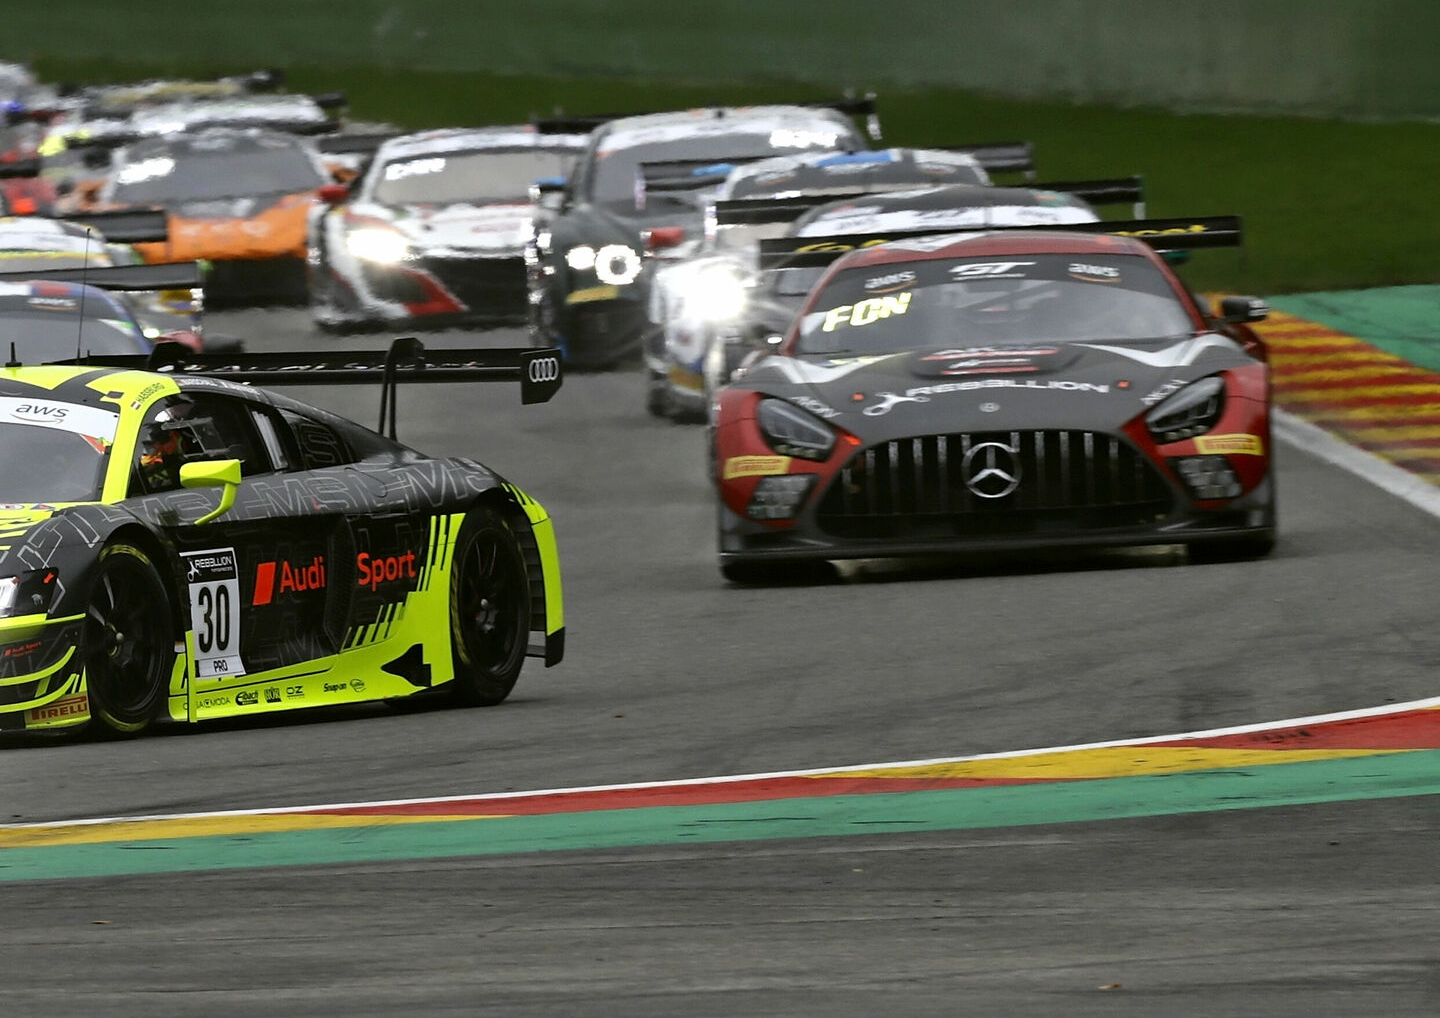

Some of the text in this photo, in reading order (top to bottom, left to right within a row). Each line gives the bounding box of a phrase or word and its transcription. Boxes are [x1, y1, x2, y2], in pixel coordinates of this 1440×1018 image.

[1068, 263, 1120, 277] aws
[865, 271, 916, 289] aws
[15, 403, 72, 419] aws
[194, 556, 233, 569] REBELLION
[280, 549, 417, 593] Audi Sport
[198, 584, 230, 653] 30
[213, 660, 228, 673] PRO
[287, 685, 303, 695] OZ
[31, 696, 88, 720] PIRELLI
